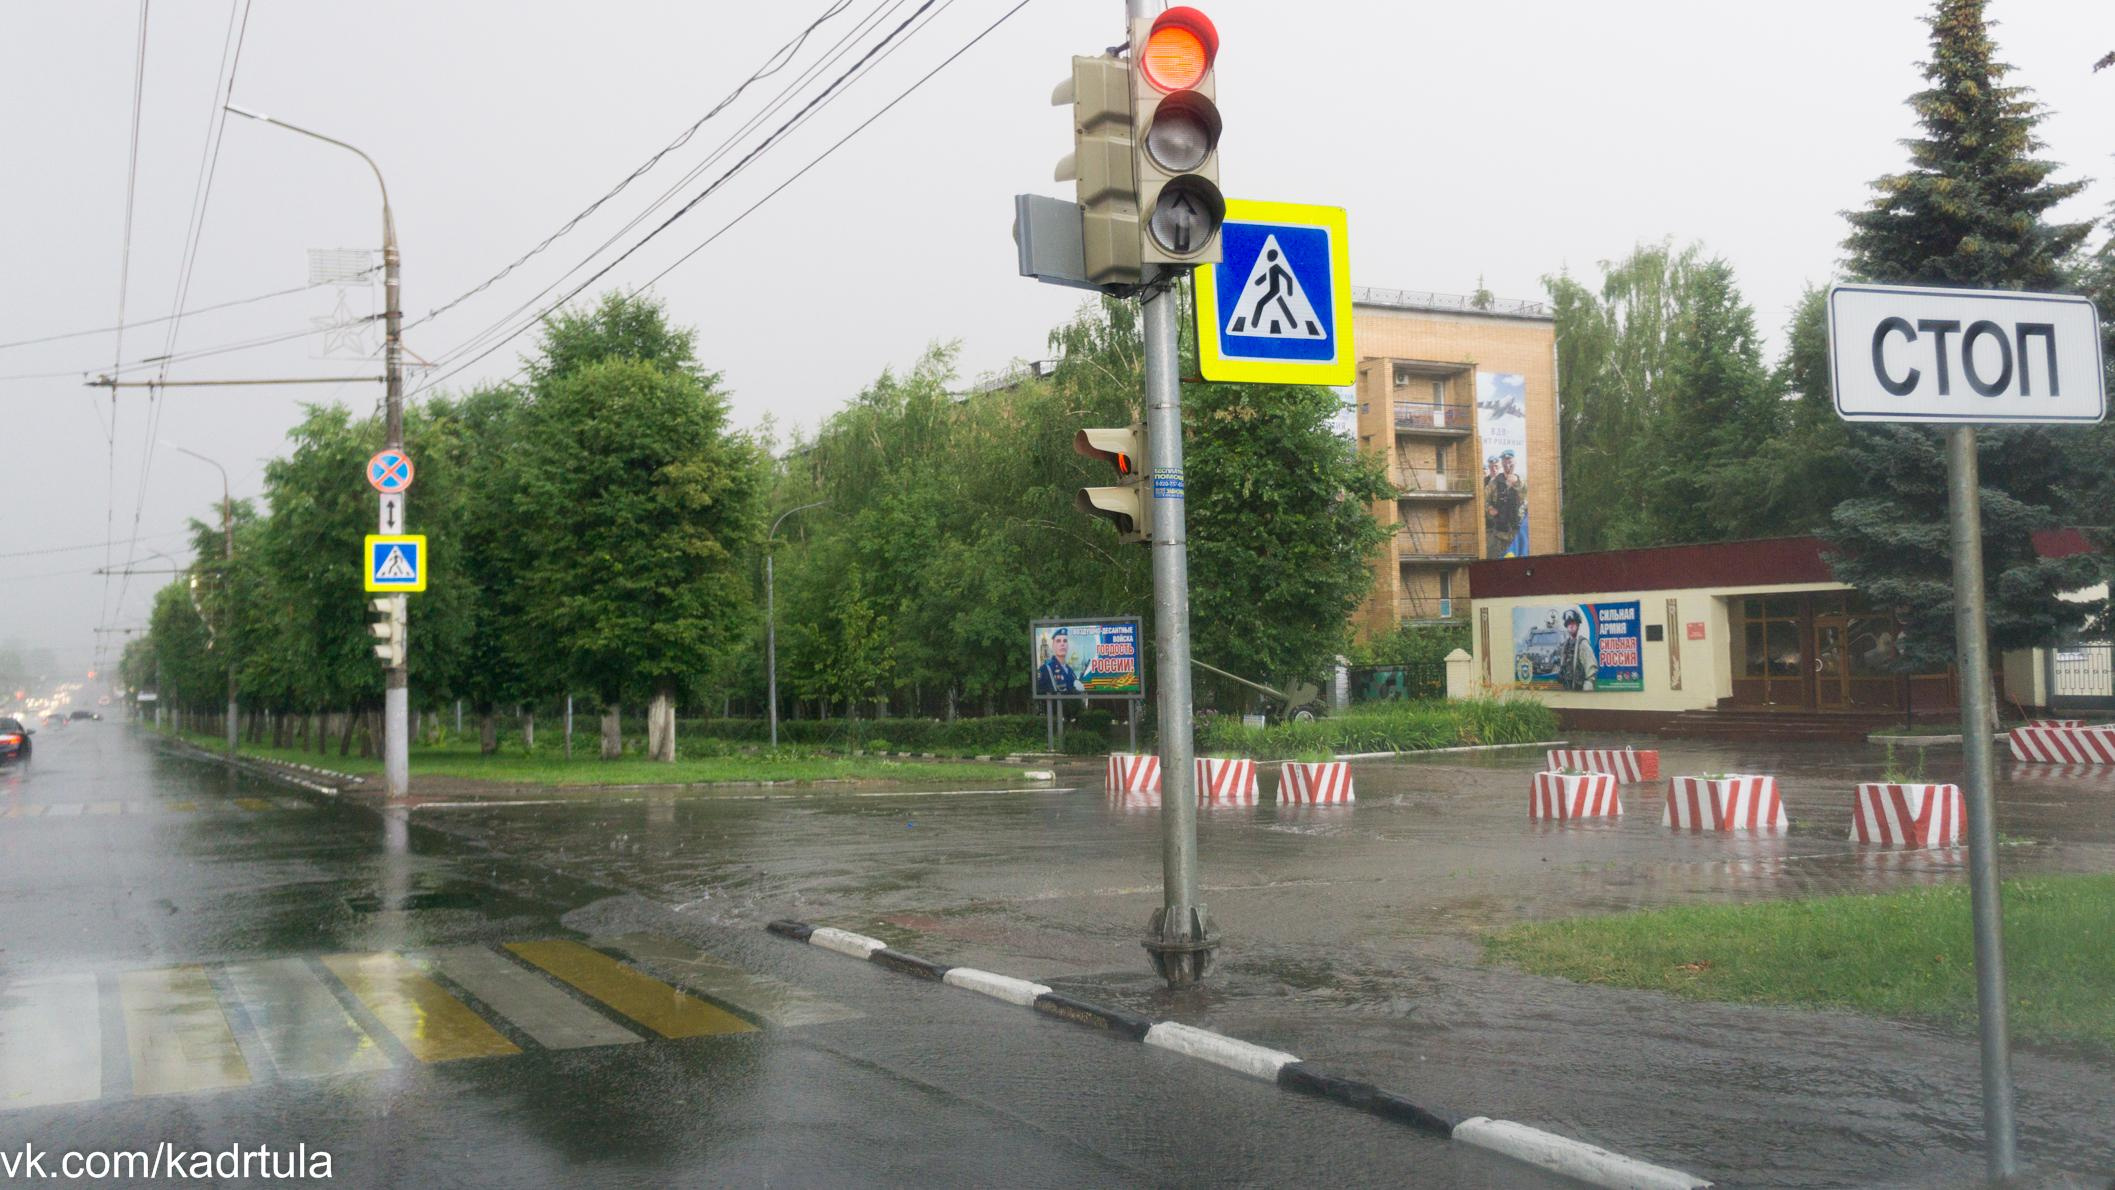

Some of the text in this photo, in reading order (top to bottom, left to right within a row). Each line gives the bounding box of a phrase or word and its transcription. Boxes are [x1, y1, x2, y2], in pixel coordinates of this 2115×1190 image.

[1872, 317, 2060, 397] СТОП
[1599, 608, 1635, 621] СИЛЬНАЯ
[1599, 622, 1627, 635] АРМИЯ
[1112, 634, 1134, 643] ВОЙСКА
[1599, 637, 1637, 650] СИЛЬНАЯ
[1096, 643, 1135, 656] ГОРДОСТЬ
[1091, 658, 1135, 673] РОССИИ!
[1600, 651, 1638, 667] РОССИЯ
